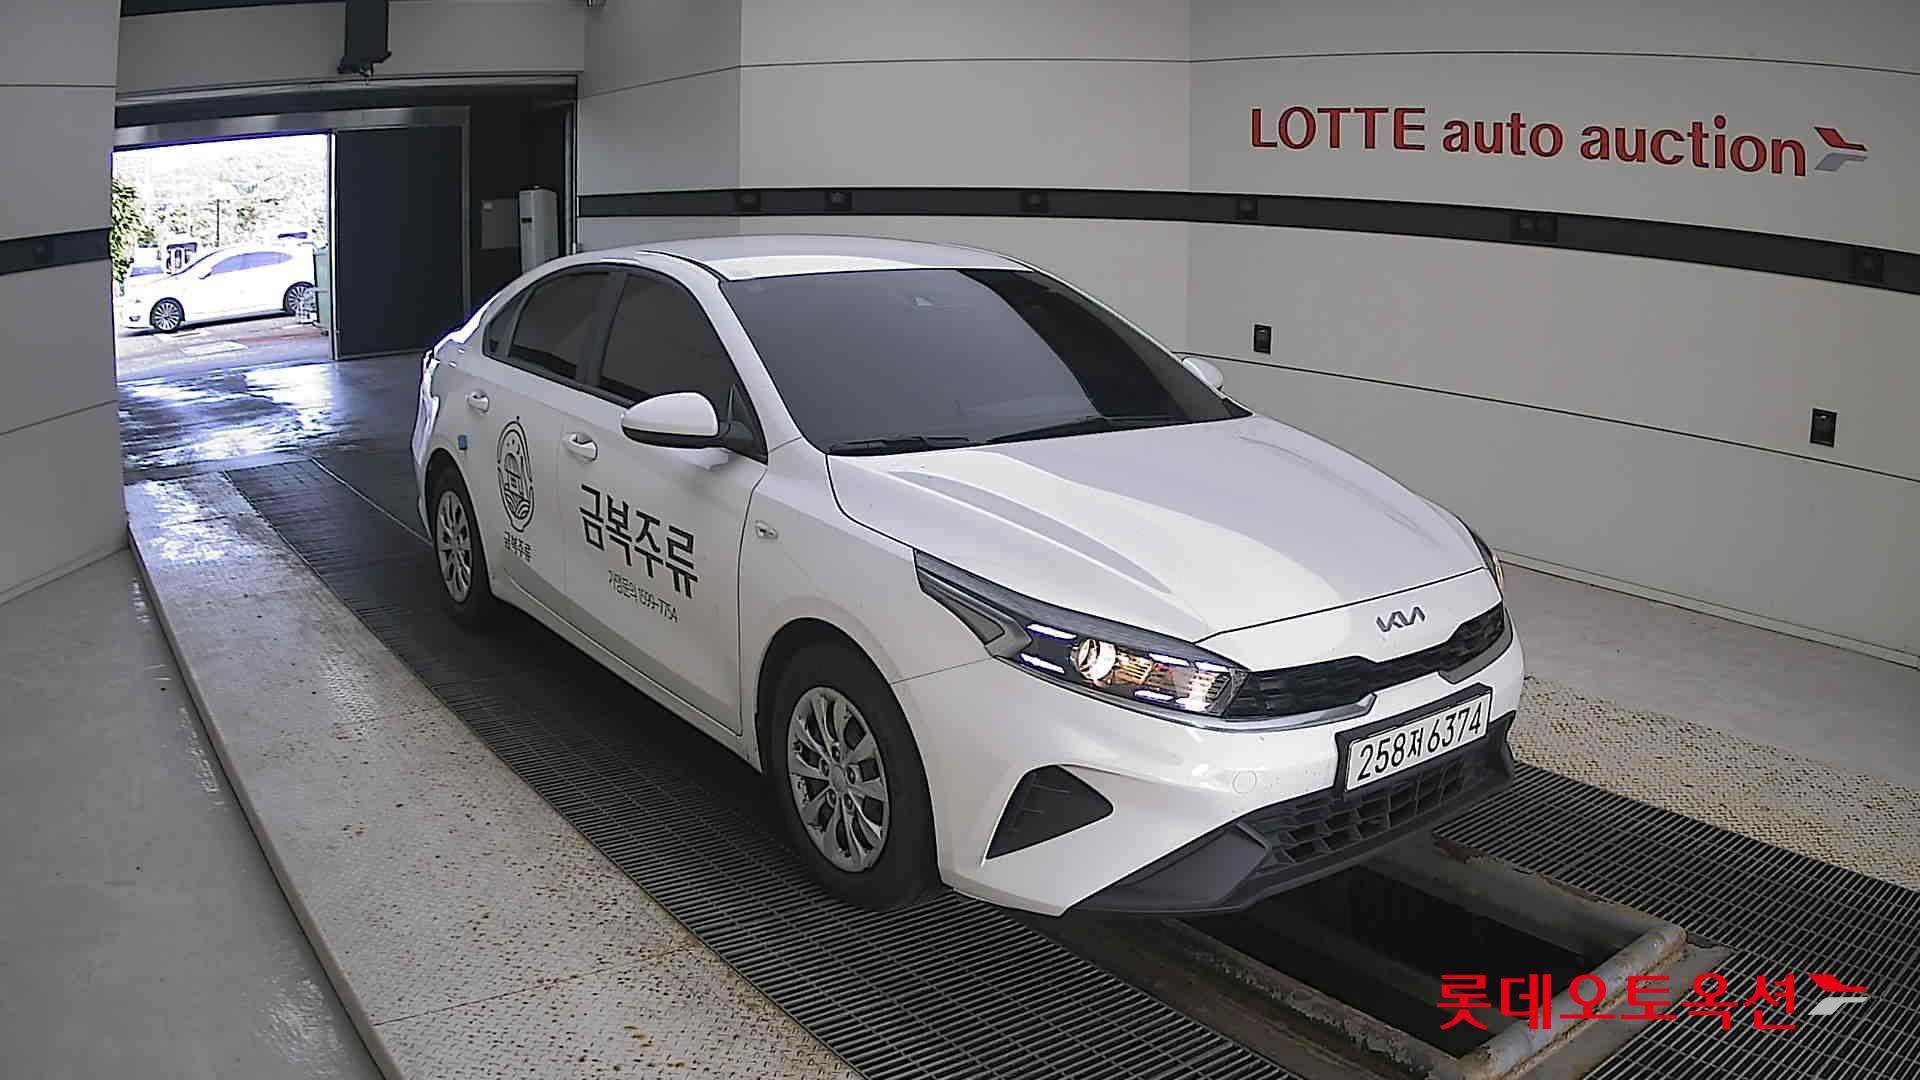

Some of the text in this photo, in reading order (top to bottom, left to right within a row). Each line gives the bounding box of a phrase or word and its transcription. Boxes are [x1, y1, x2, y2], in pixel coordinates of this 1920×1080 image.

[1250, 105, 1807, 177] LOTTE auto auction
[579, 483, 698, 599] 금복주류
